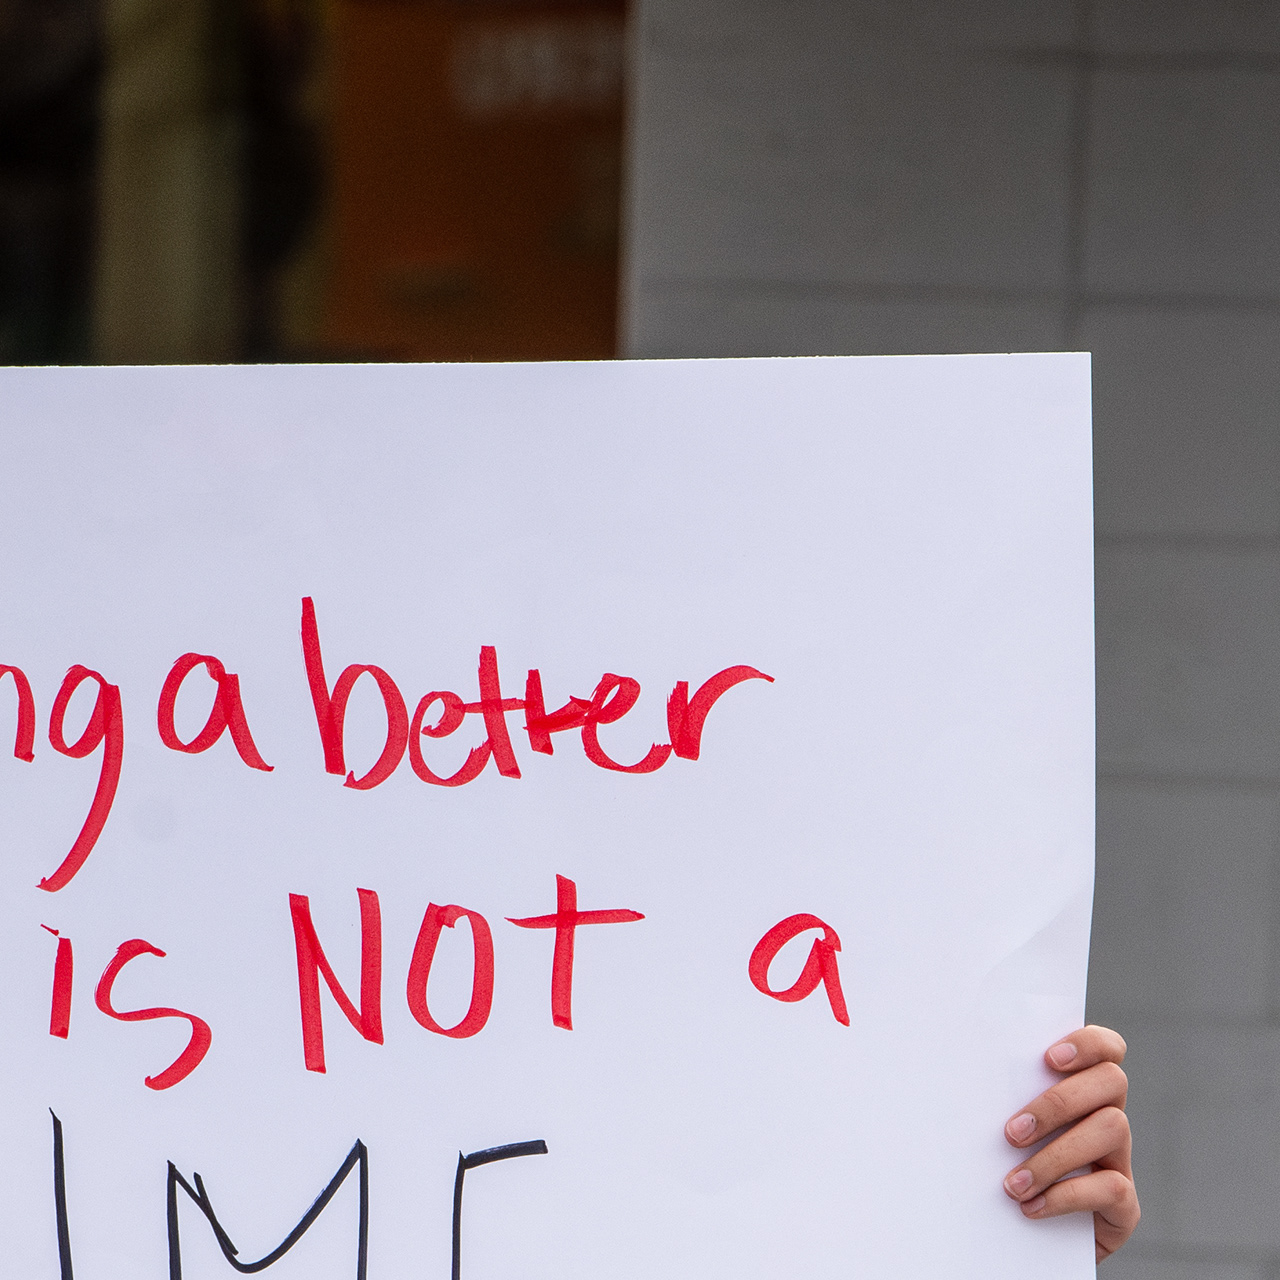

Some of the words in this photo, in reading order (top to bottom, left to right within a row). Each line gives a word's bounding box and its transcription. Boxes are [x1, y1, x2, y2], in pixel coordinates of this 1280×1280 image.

[158, 653, 274, 771] a
[301, 597, 774, 790] better
[46, 925, 211, 1091] is
[749, 913, 849, 1026] a
